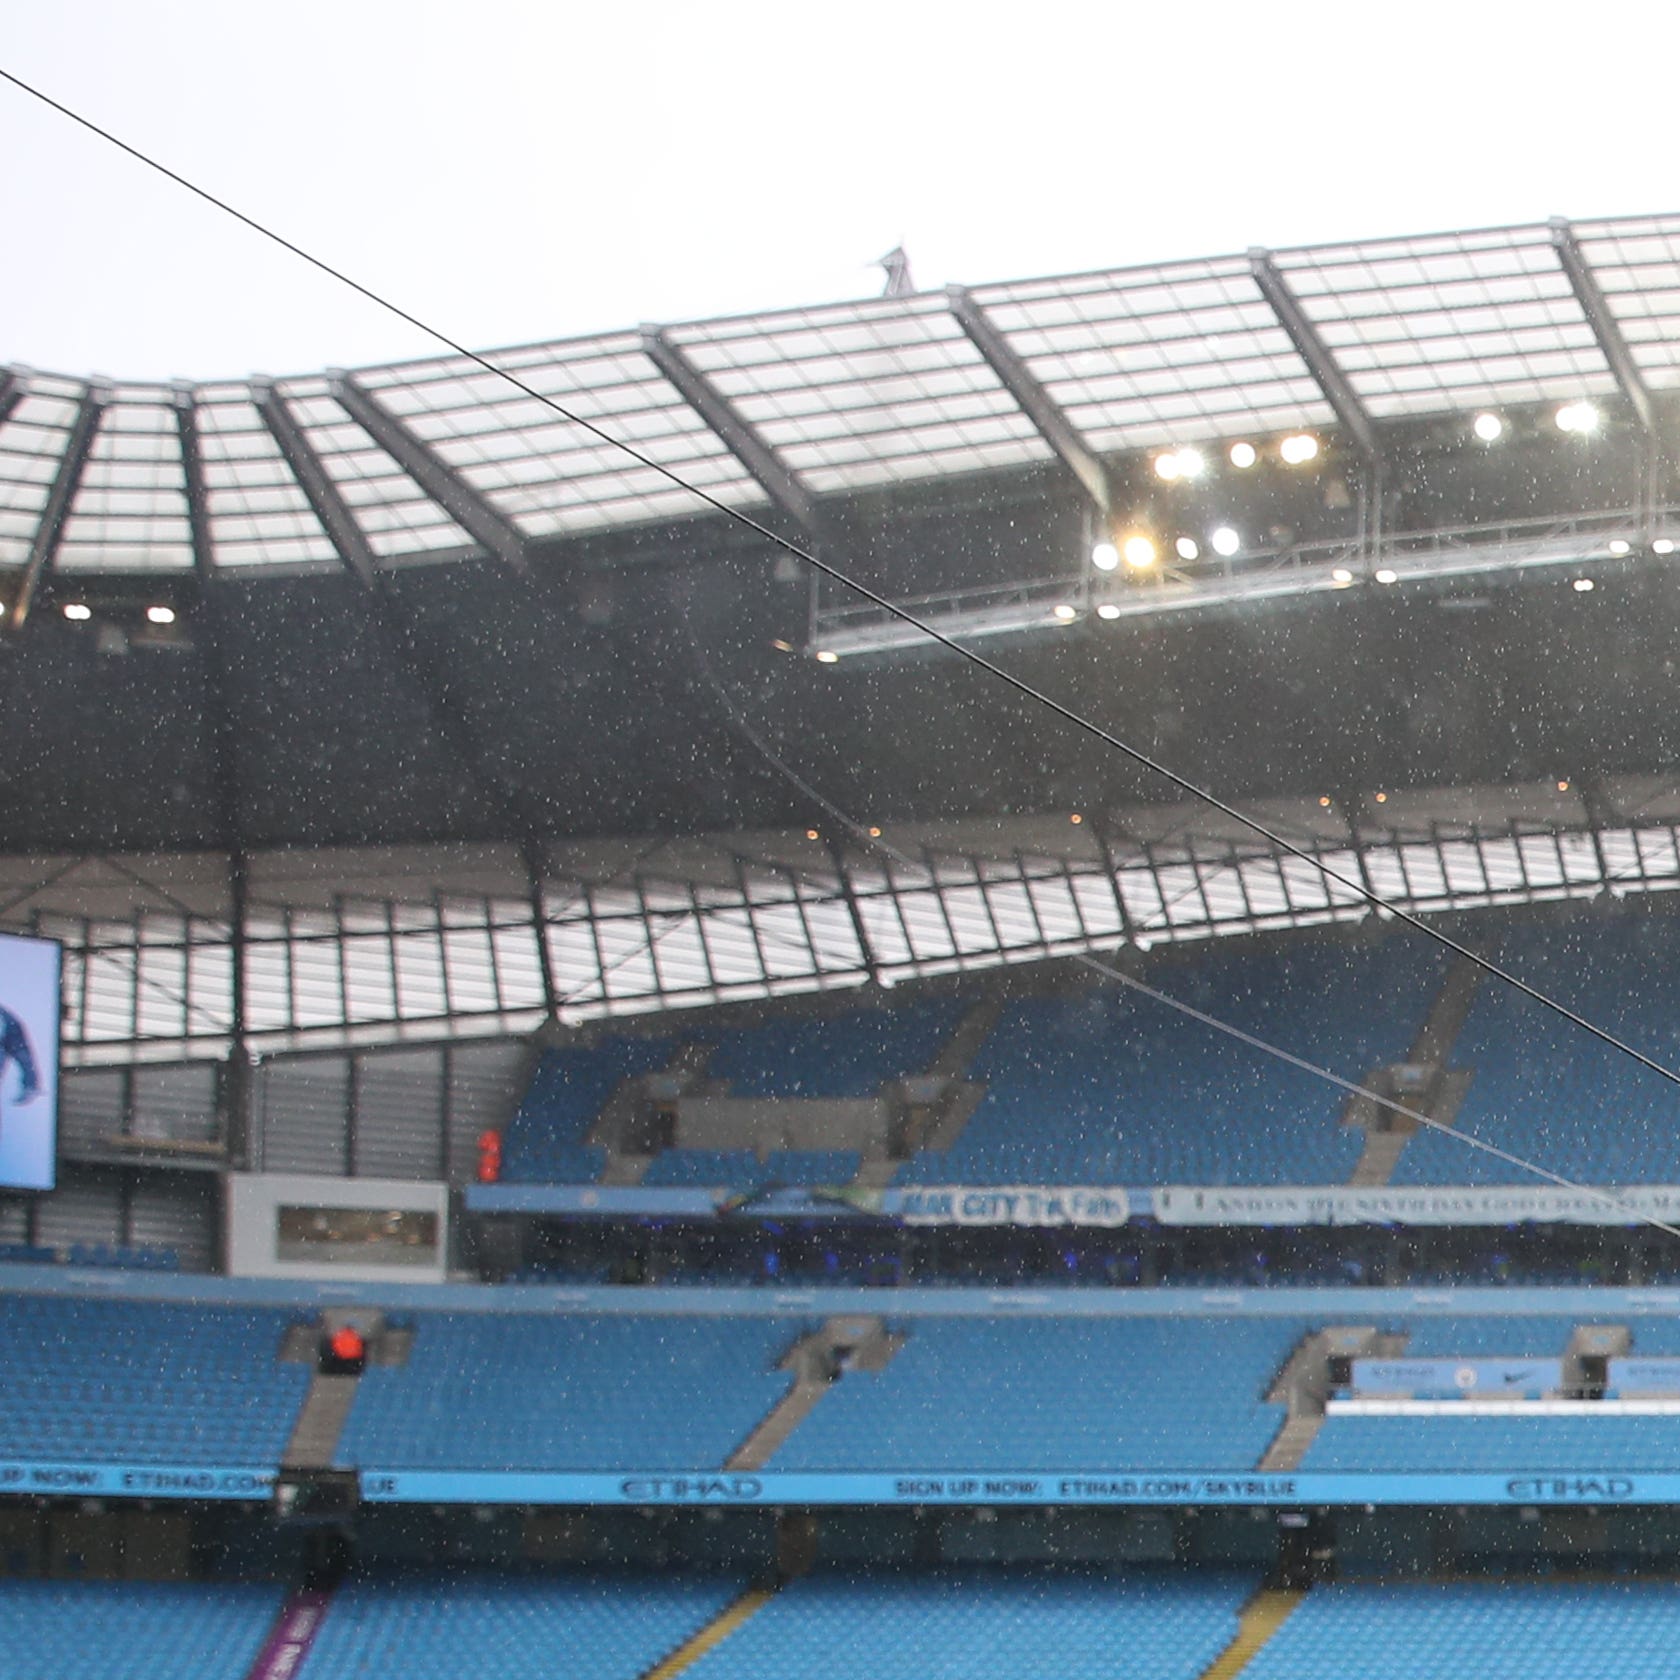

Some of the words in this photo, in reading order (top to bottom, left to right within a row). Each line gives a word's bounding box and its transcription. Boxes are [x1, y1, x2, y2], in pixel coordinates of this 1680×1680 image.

[620, 1478, 764, 1499] ETIHAD
[948, 1479, 979, 1497] UP
[1505, 1478, 1635, 1498] ETIHAD
